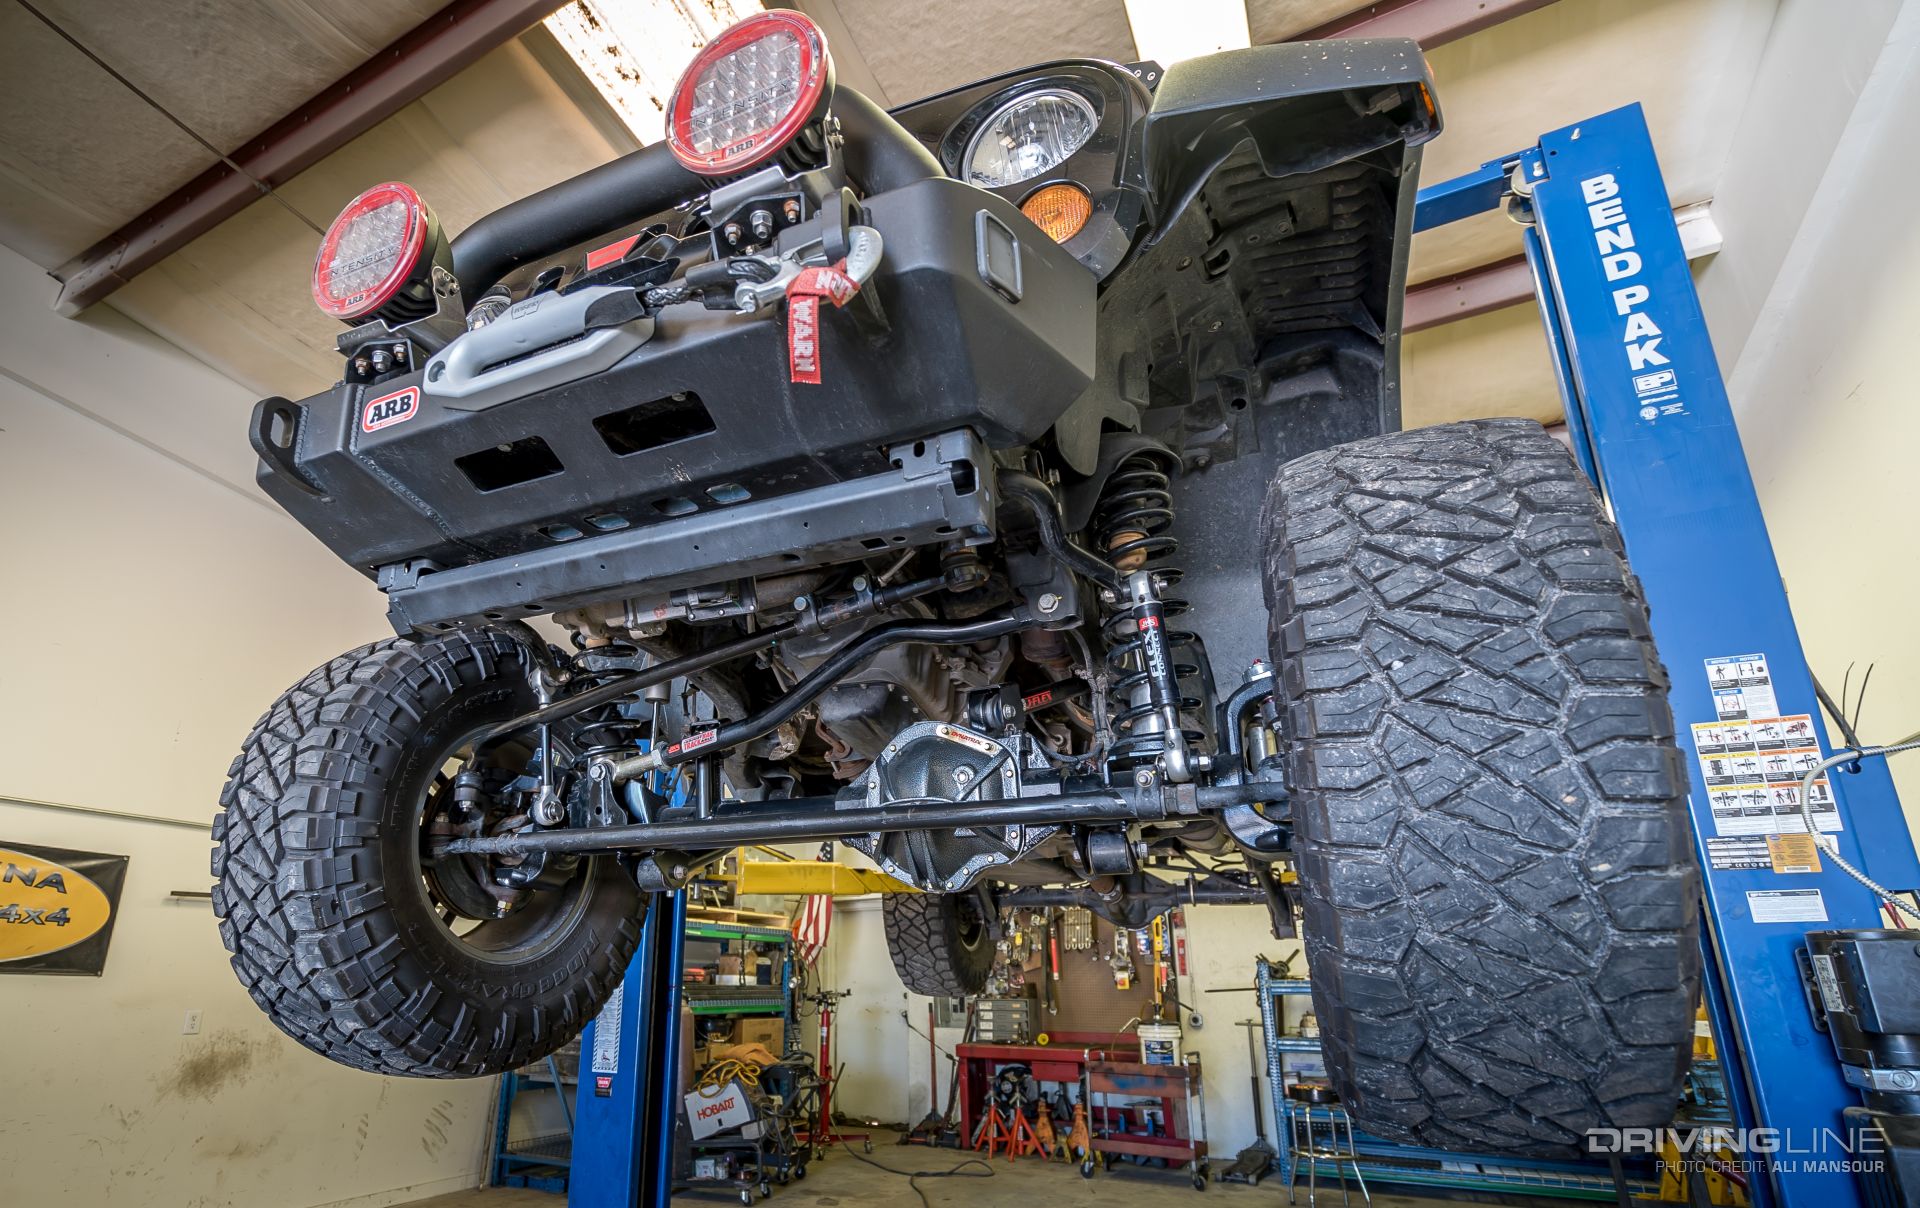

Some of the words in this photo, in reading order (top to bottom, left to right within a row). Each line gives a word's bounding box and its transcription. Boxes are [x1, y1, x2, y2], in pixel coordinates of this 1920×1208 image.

[727, 139, 754, 156] ARB
[793, 300, 815, 372] WARN
[369, 394, 411, 424] ARB
[1143, 629, 1161, 678] FLEX
[0, 862, 67, 894] NA
[697, 1097, 735, 1121] HOBART
